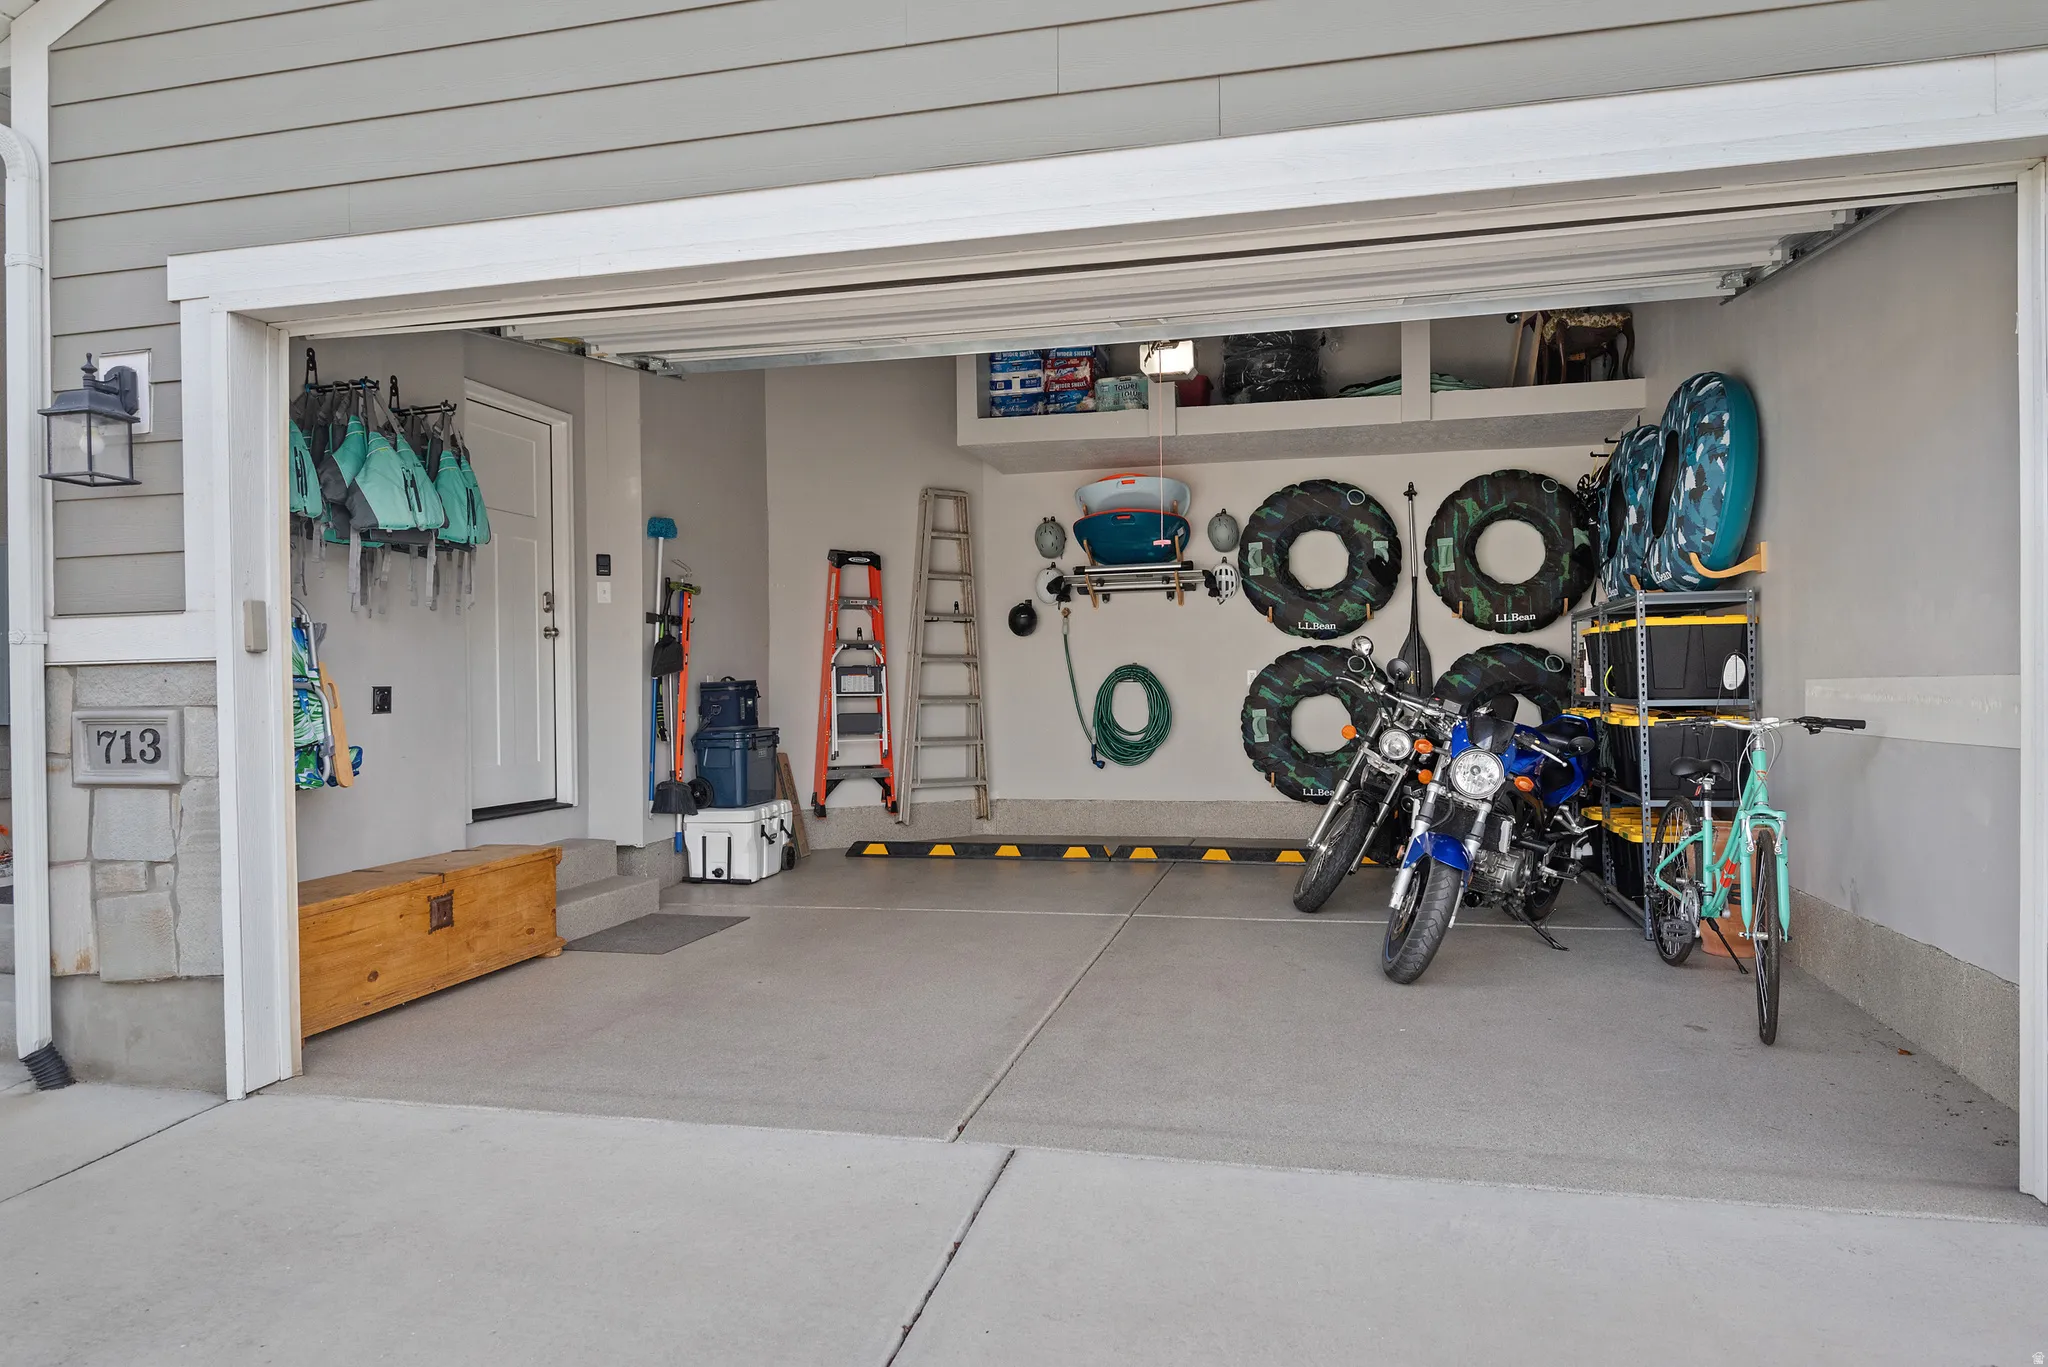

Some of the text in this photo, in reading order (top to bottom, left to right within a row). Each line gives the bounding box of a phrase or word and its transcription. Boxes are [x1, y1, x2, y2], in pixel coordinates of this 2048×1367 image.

[1495, 612, 1536, 623] L.L.Bean
[1297, 621, 1336, 630] L.L.Bean
[96, 727, 162, 765] 713
[1302, 788, 1335, 797] L.L.Bea
